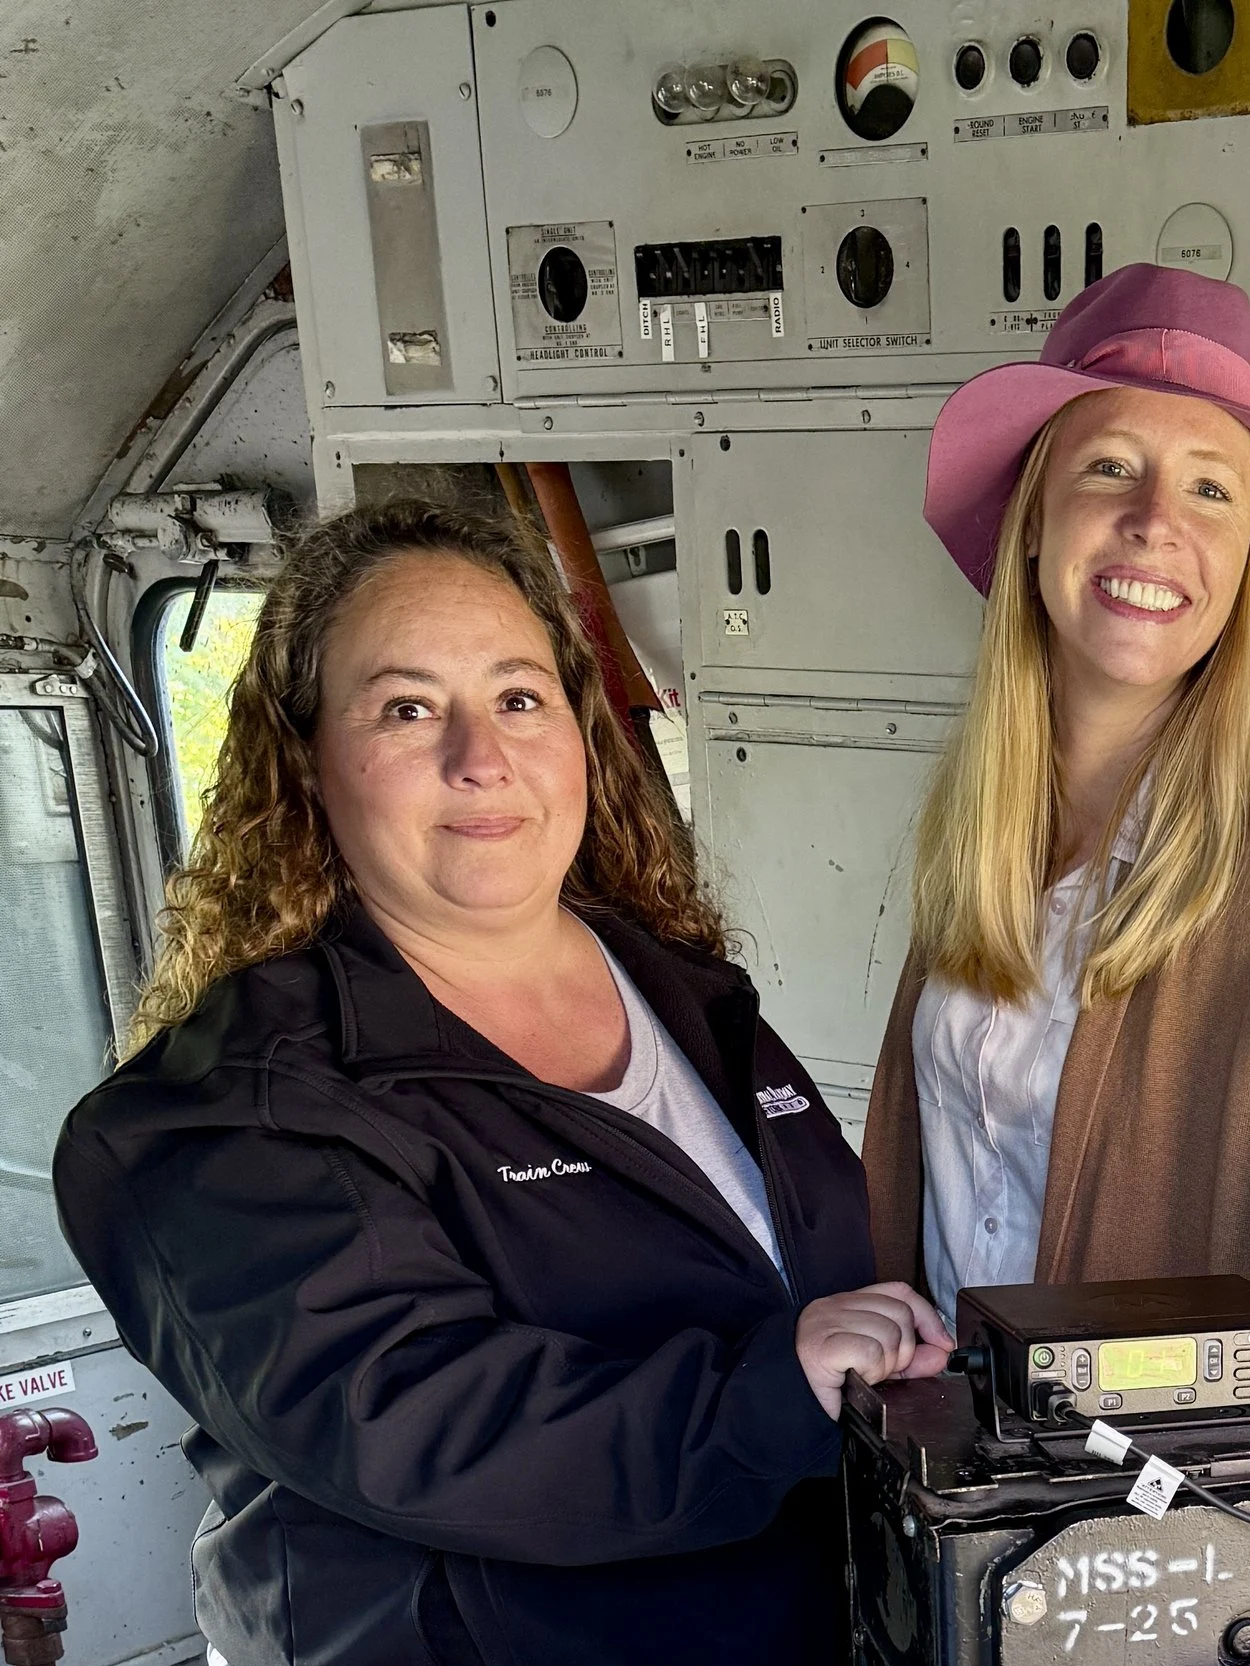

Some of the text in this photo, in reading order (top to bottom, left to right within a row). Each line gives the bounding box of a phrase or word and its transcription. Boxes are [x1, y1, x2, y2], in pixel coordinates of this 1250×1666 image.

[1018, 115, 1043, 125] ENGINE
[972, 129, 989, 137] RESET
[1022, 124, 1042, 134] START
[770, 137, 784, 145] LOW
[694, 152, 716, 160] ENGINE
[730, 148, 752, 156] POWER
[1181, 249, 1201, 258] 6076
[820, 336, 917, 349] UNIT SELECTOR SWITCH
[530, 348, 608, 360] HEADLIGHT CONTROL
[497, 1159, 592, 1182] Train Crew
[19, 1370, 68, 1396] VALVE
[1056, 1598, 1198, 1652] 7-25
